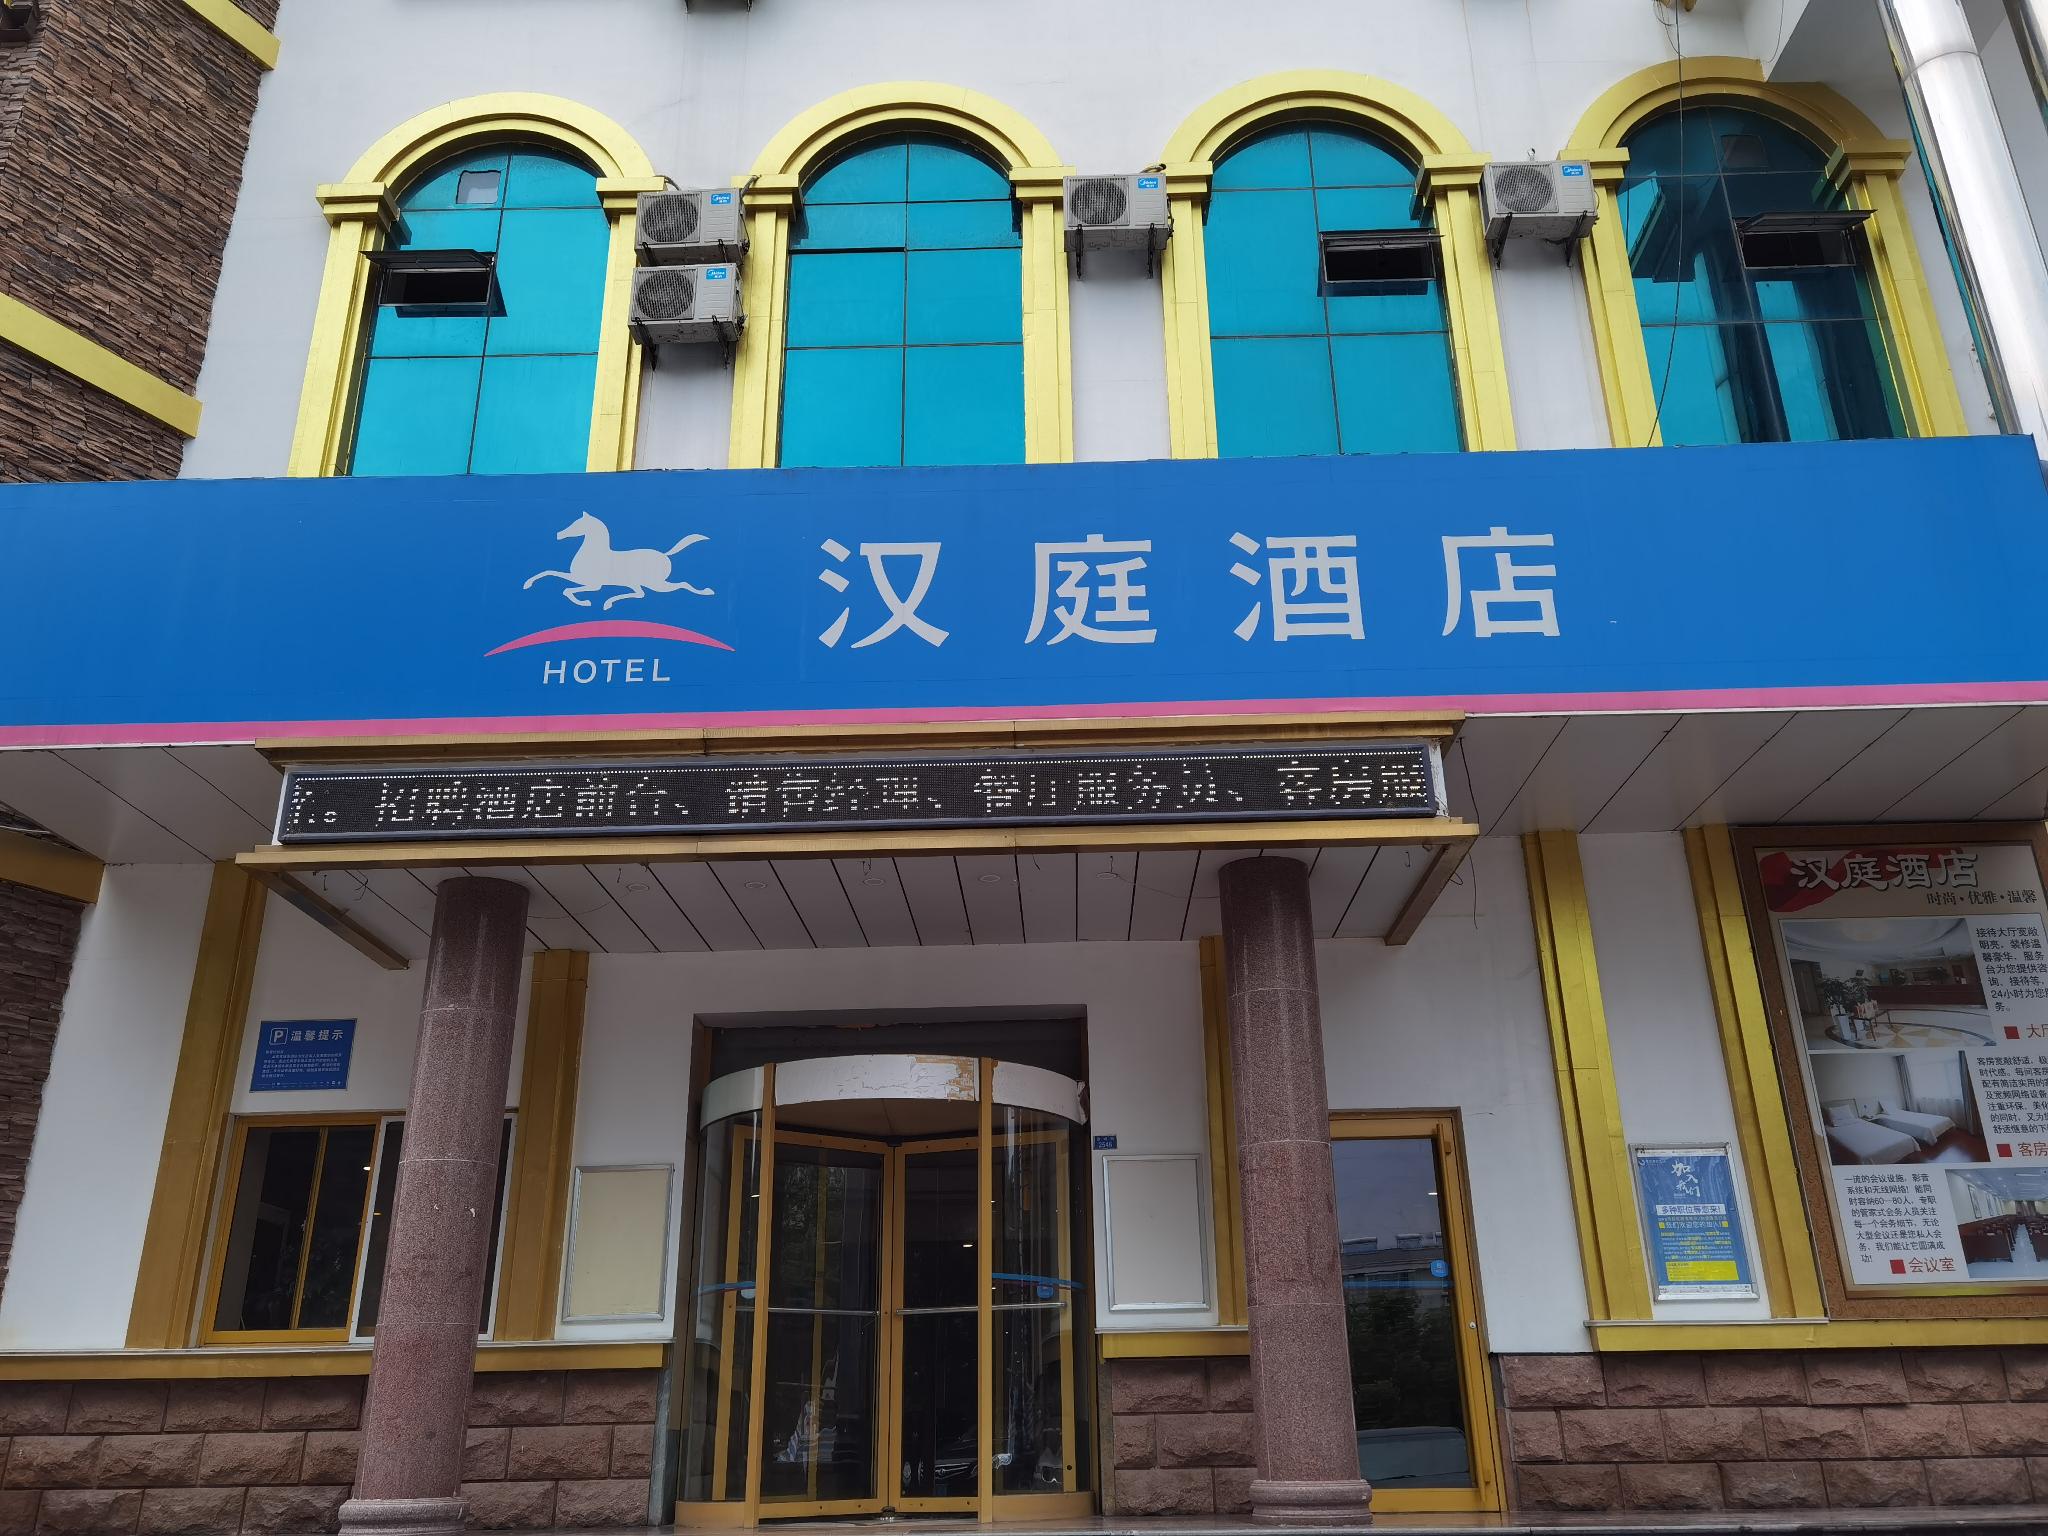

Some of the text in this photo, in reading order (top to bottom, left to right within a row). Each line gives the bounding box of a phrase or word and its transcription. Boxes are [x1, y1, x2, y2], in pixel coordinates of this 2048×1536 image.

[818, 526, 1561, 649] 汉庭酒店
[543, 658, 671, 685] HOTEL
[1790, 851, 1979, 891] 汉庭酒店
[290, 1029, 344, 1042] 温馨提示
[1908, 1257, 1956, 1274] 会议室
